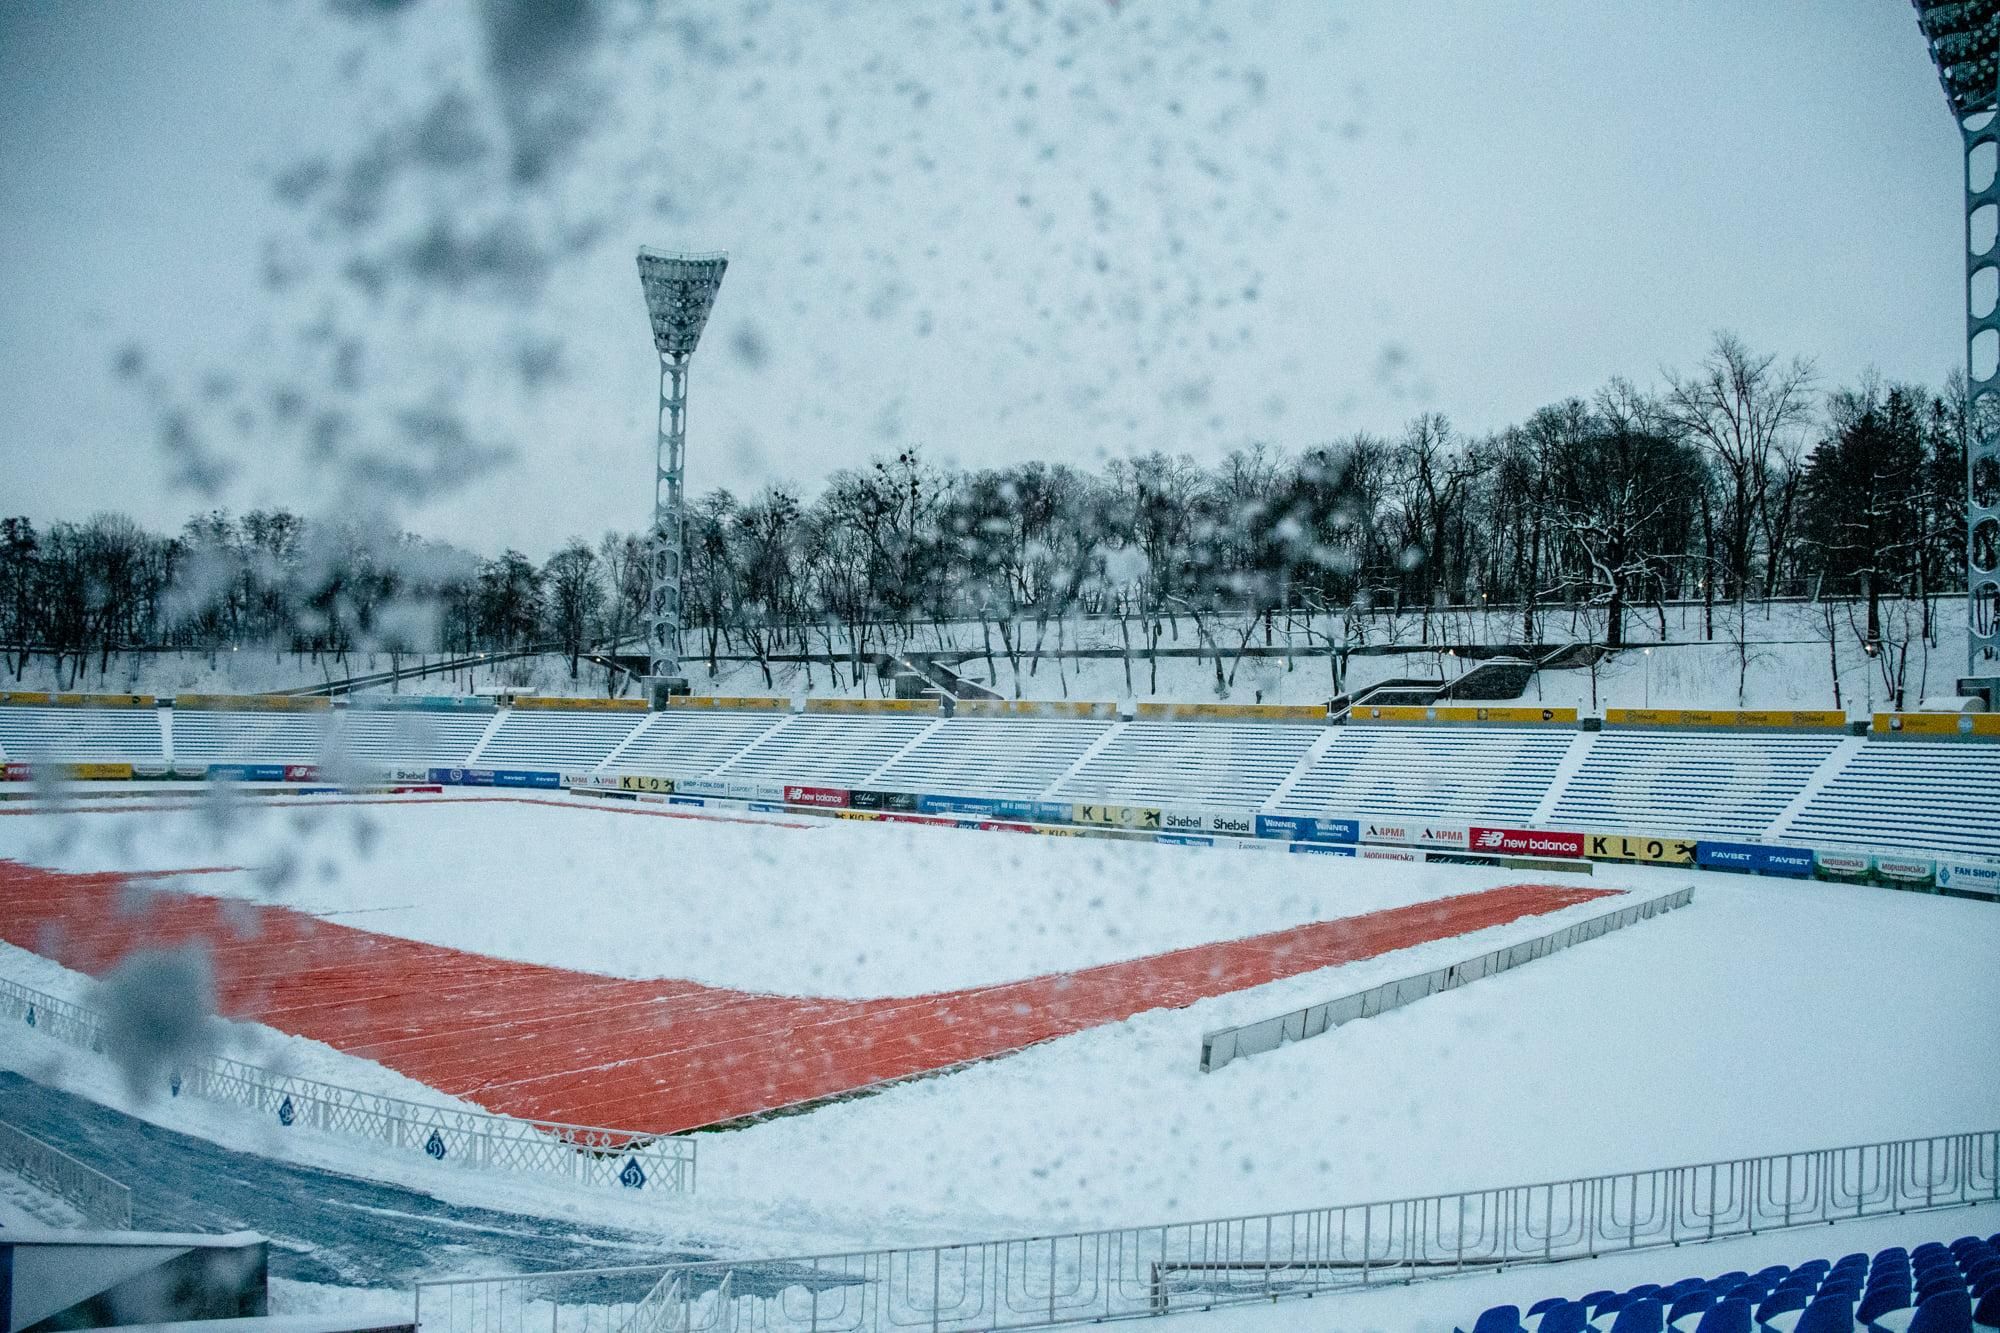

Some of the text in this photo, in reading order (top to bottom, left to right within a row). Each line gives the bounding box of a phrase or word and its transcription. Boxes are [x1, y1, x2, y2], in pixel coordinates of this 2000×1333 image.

[623, 777, 659, 790] KLO
[815, 794, 842, 803] balance
[1083, 806, 1132, 822] KLO
[1264, 818, 1297, 830] WINNER
[1315, 821, 1349, 833] WINNER
[1504, 839, 1527, 849] new
[1529, 838, 1577, 852] balance
[1593, 837, 1663, 858] KLO
[1711, 851, 1752, 861] FAVBET
[1769, 855, 1810, 866] FAVBET
[1954, 866, 1997, 879] FAN SHOP
